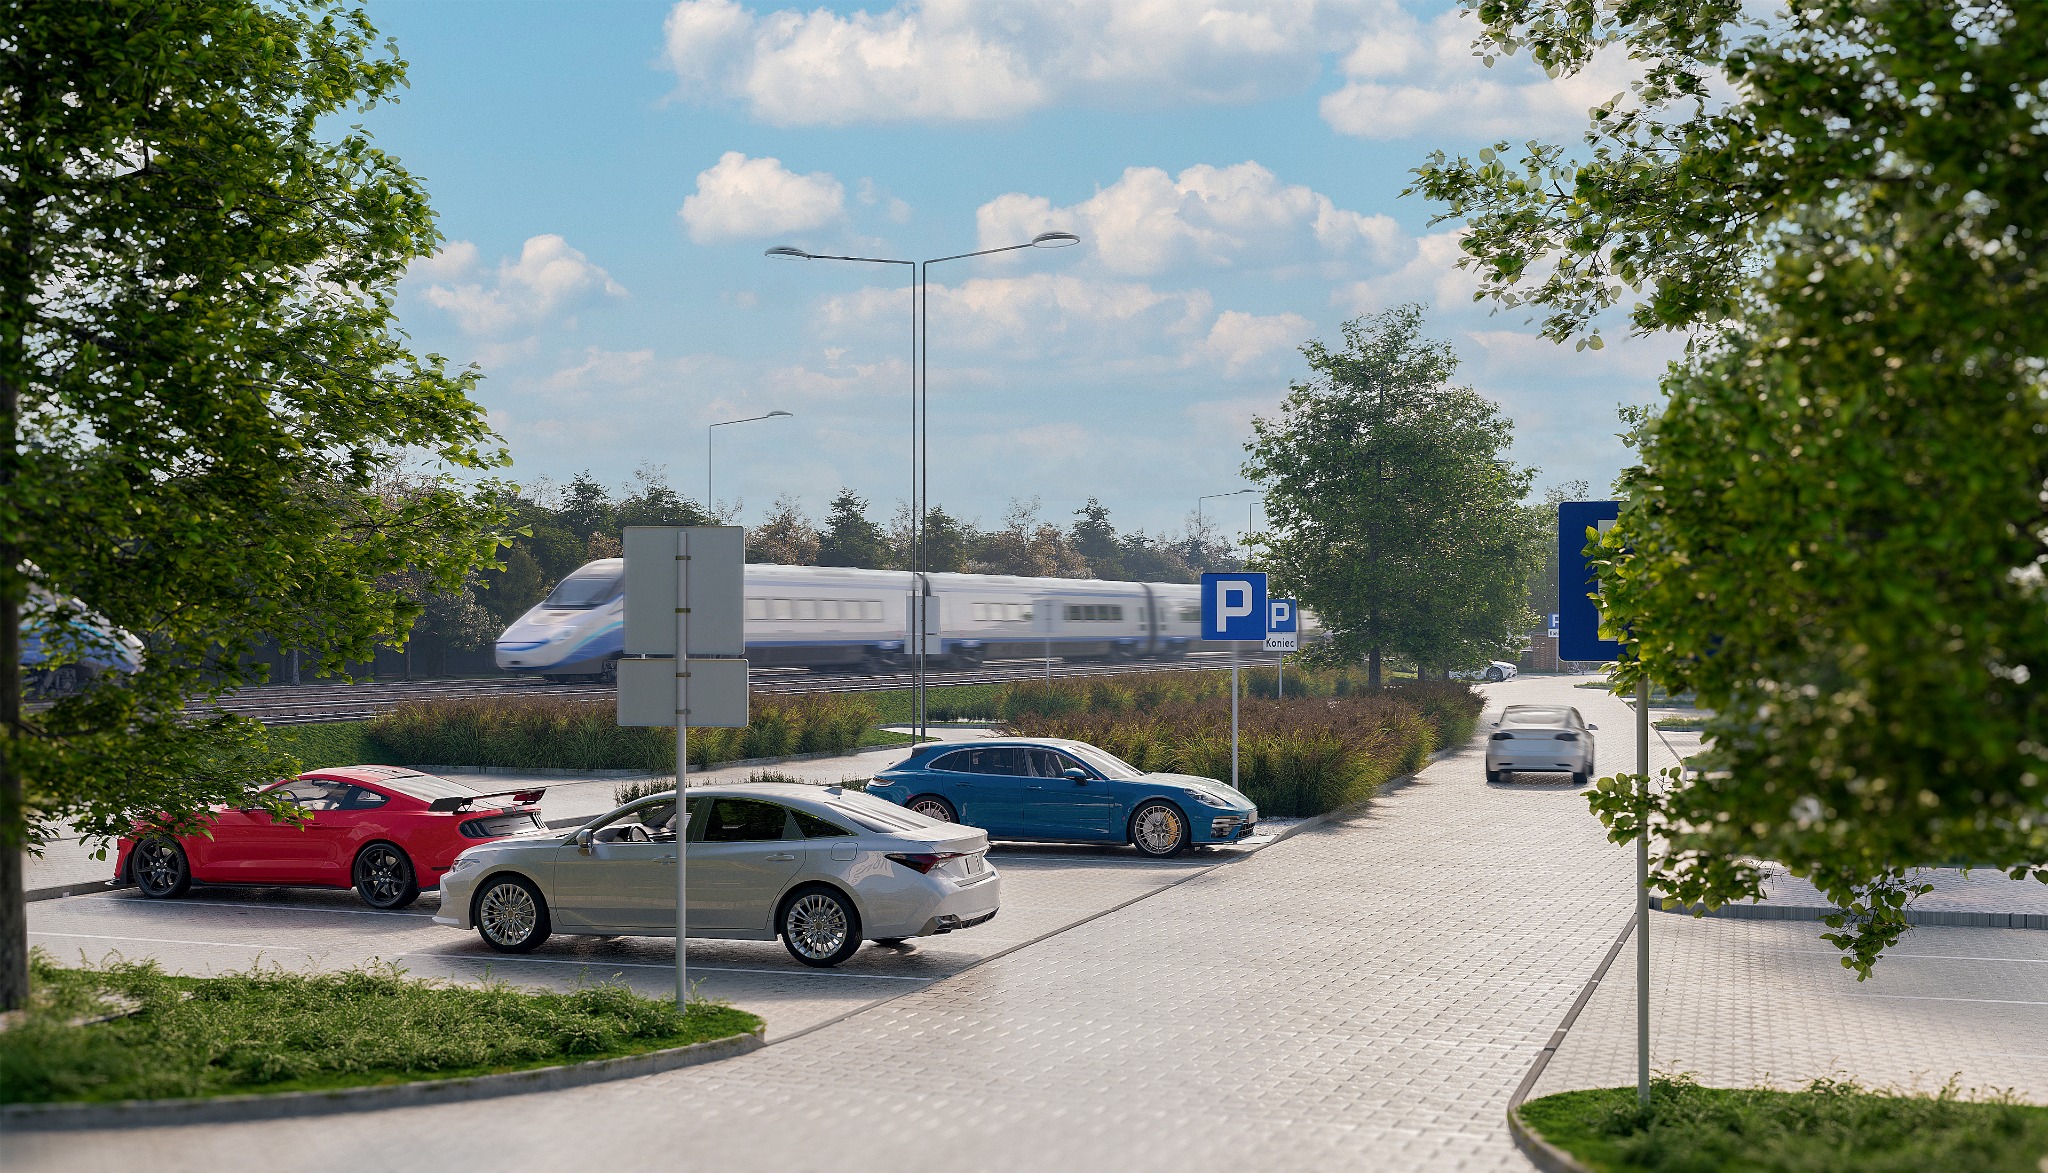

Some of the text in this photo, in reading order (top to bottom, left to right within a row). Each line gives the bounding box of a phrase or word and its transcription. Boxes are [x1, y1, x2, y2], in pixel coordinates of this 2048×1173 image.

[1217, 581, 1252, 632] P
[1271, 603, 1289, 628] P
[1266, 638, 1294, 647] Koniec
